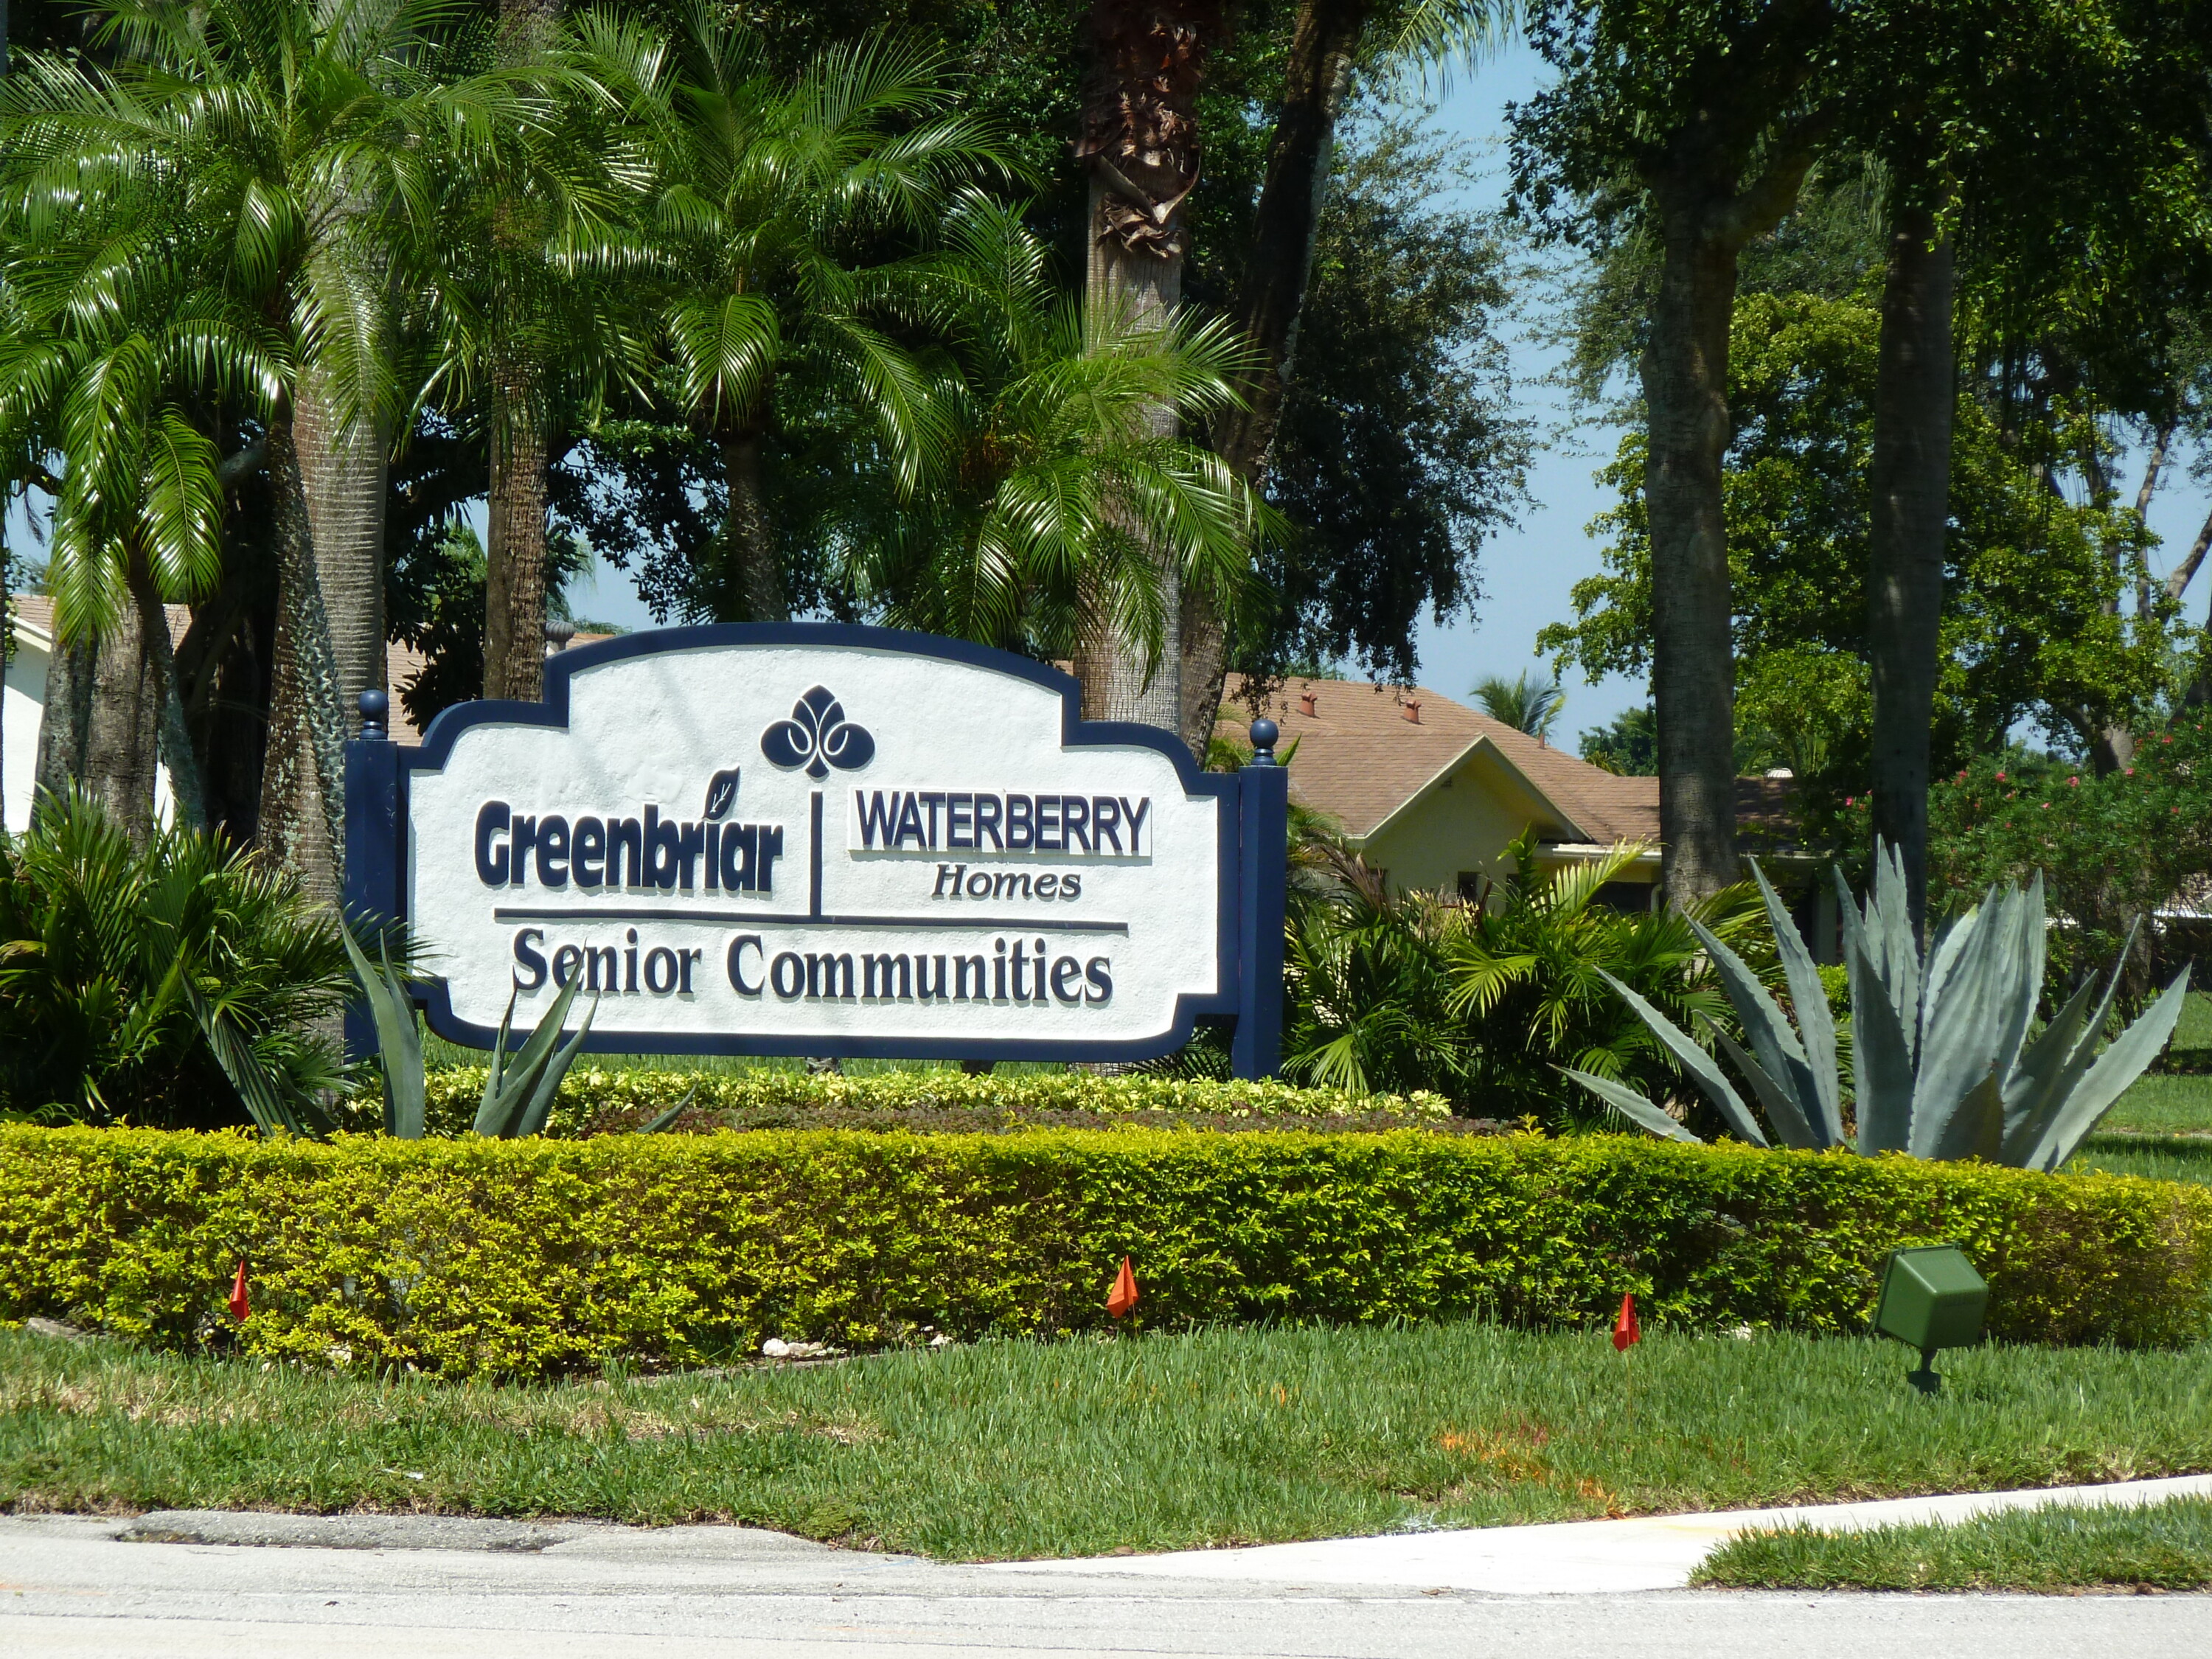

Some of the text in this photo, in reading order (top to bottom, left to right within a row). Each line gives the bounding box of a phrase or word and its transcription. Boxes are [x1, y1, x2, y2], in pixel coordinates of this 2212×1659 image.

[474, 799, 785, 892] Greenbriar
[855, 790, 1150, 852] WATERBERRY
[932, 863, 1082, 897] Homes
[512, 928, 1113, 1003] Senior Communities
